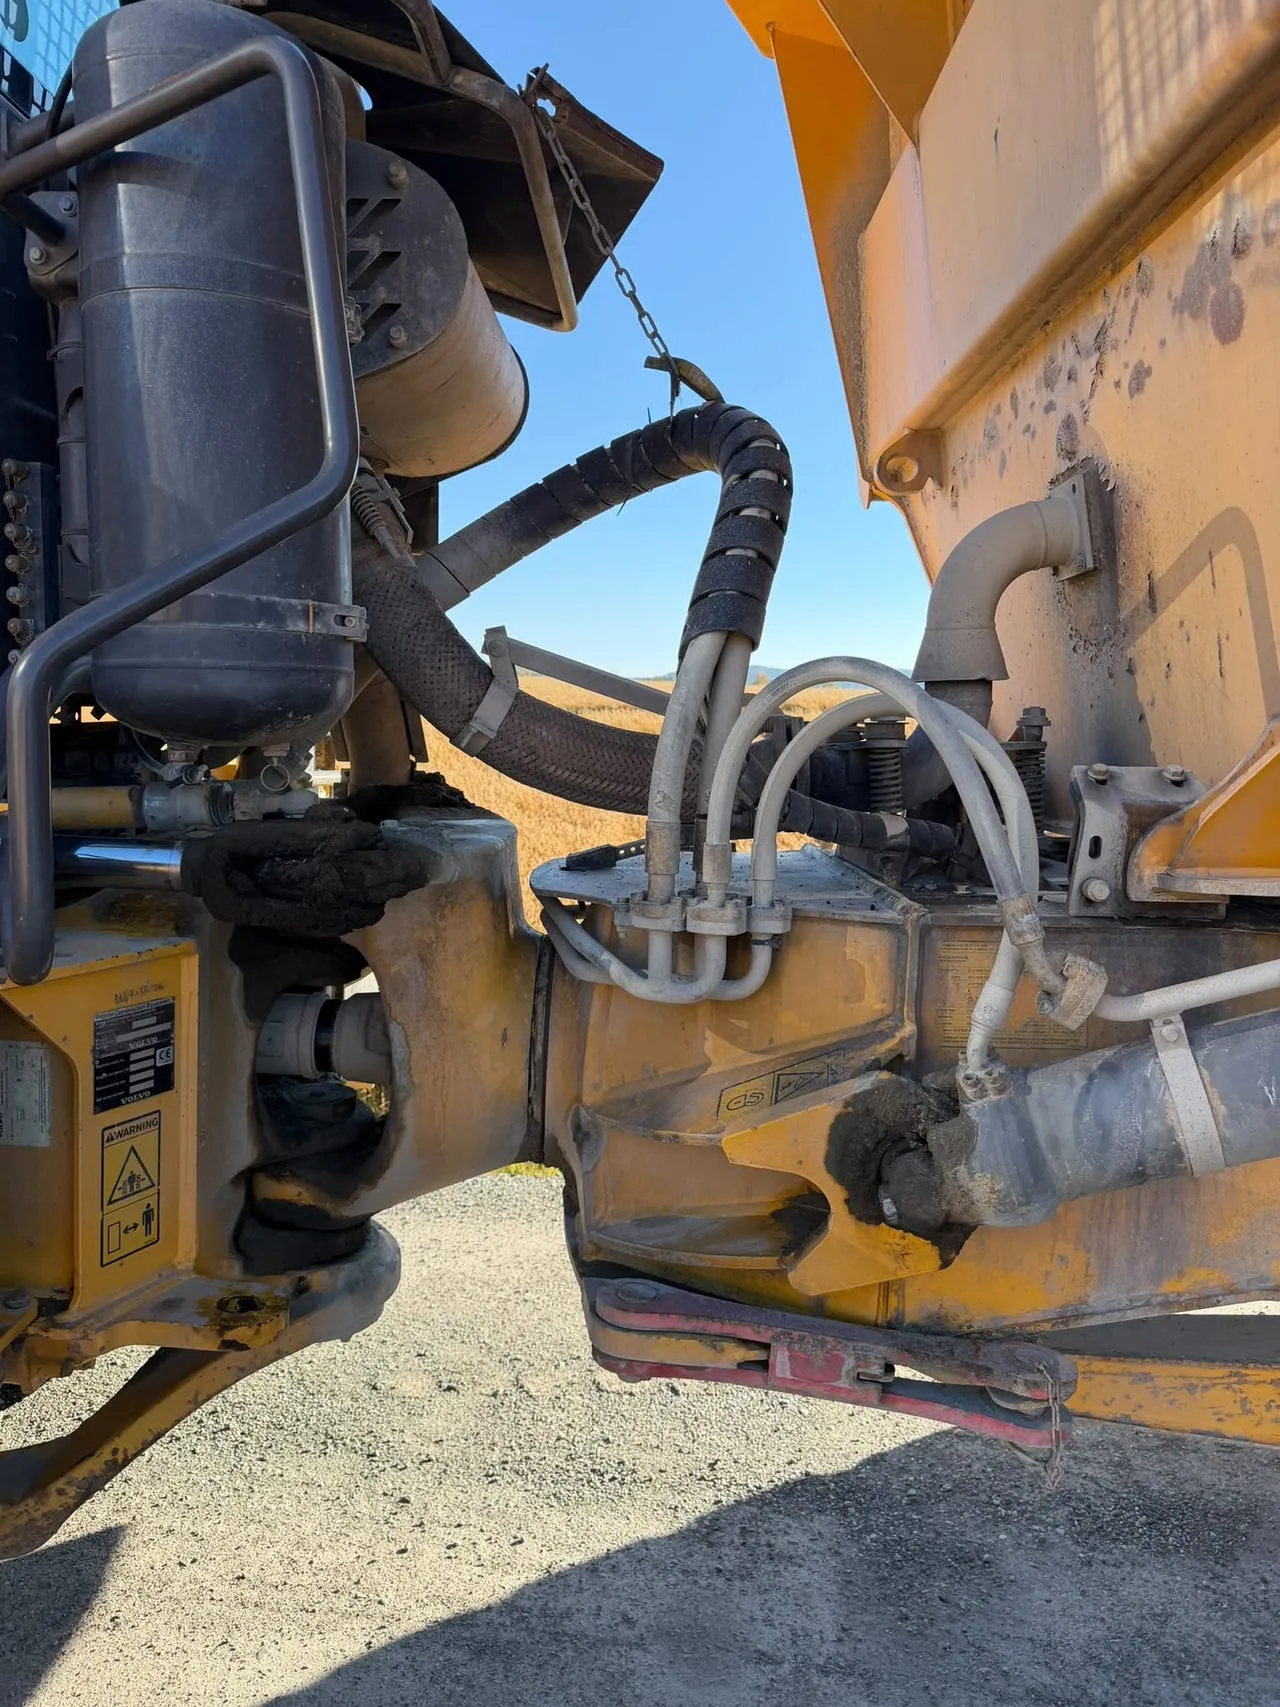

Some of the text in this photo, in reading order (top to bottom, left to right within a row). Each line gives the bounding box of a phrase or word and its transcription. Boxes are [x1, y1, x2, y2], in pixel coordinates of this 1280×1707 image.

[128, 1036, 158, 1049] VOLVO
[120, 1090, 151, 1105] VOLVO
[114, 1117, 159, 1140] WARNING
